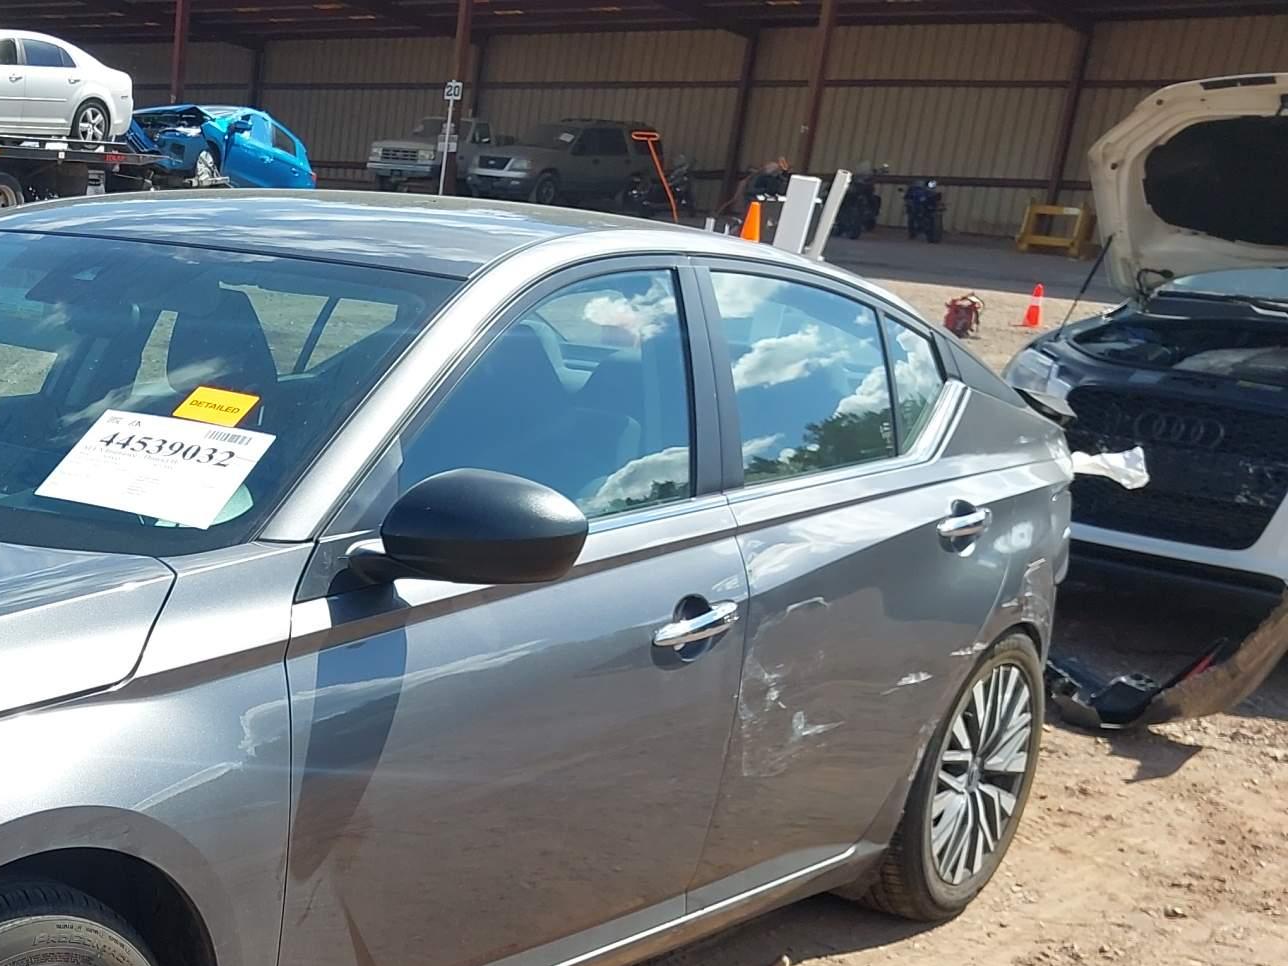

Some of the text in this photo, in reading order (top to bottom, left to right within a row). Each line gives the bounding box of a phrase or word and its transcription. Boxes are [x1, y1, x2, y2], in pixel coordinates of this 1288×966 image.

[446, 85, 460, 97] 20
[189, 399, 241, 415] DETAILED
[99, 431, 236, 468] 44539032
